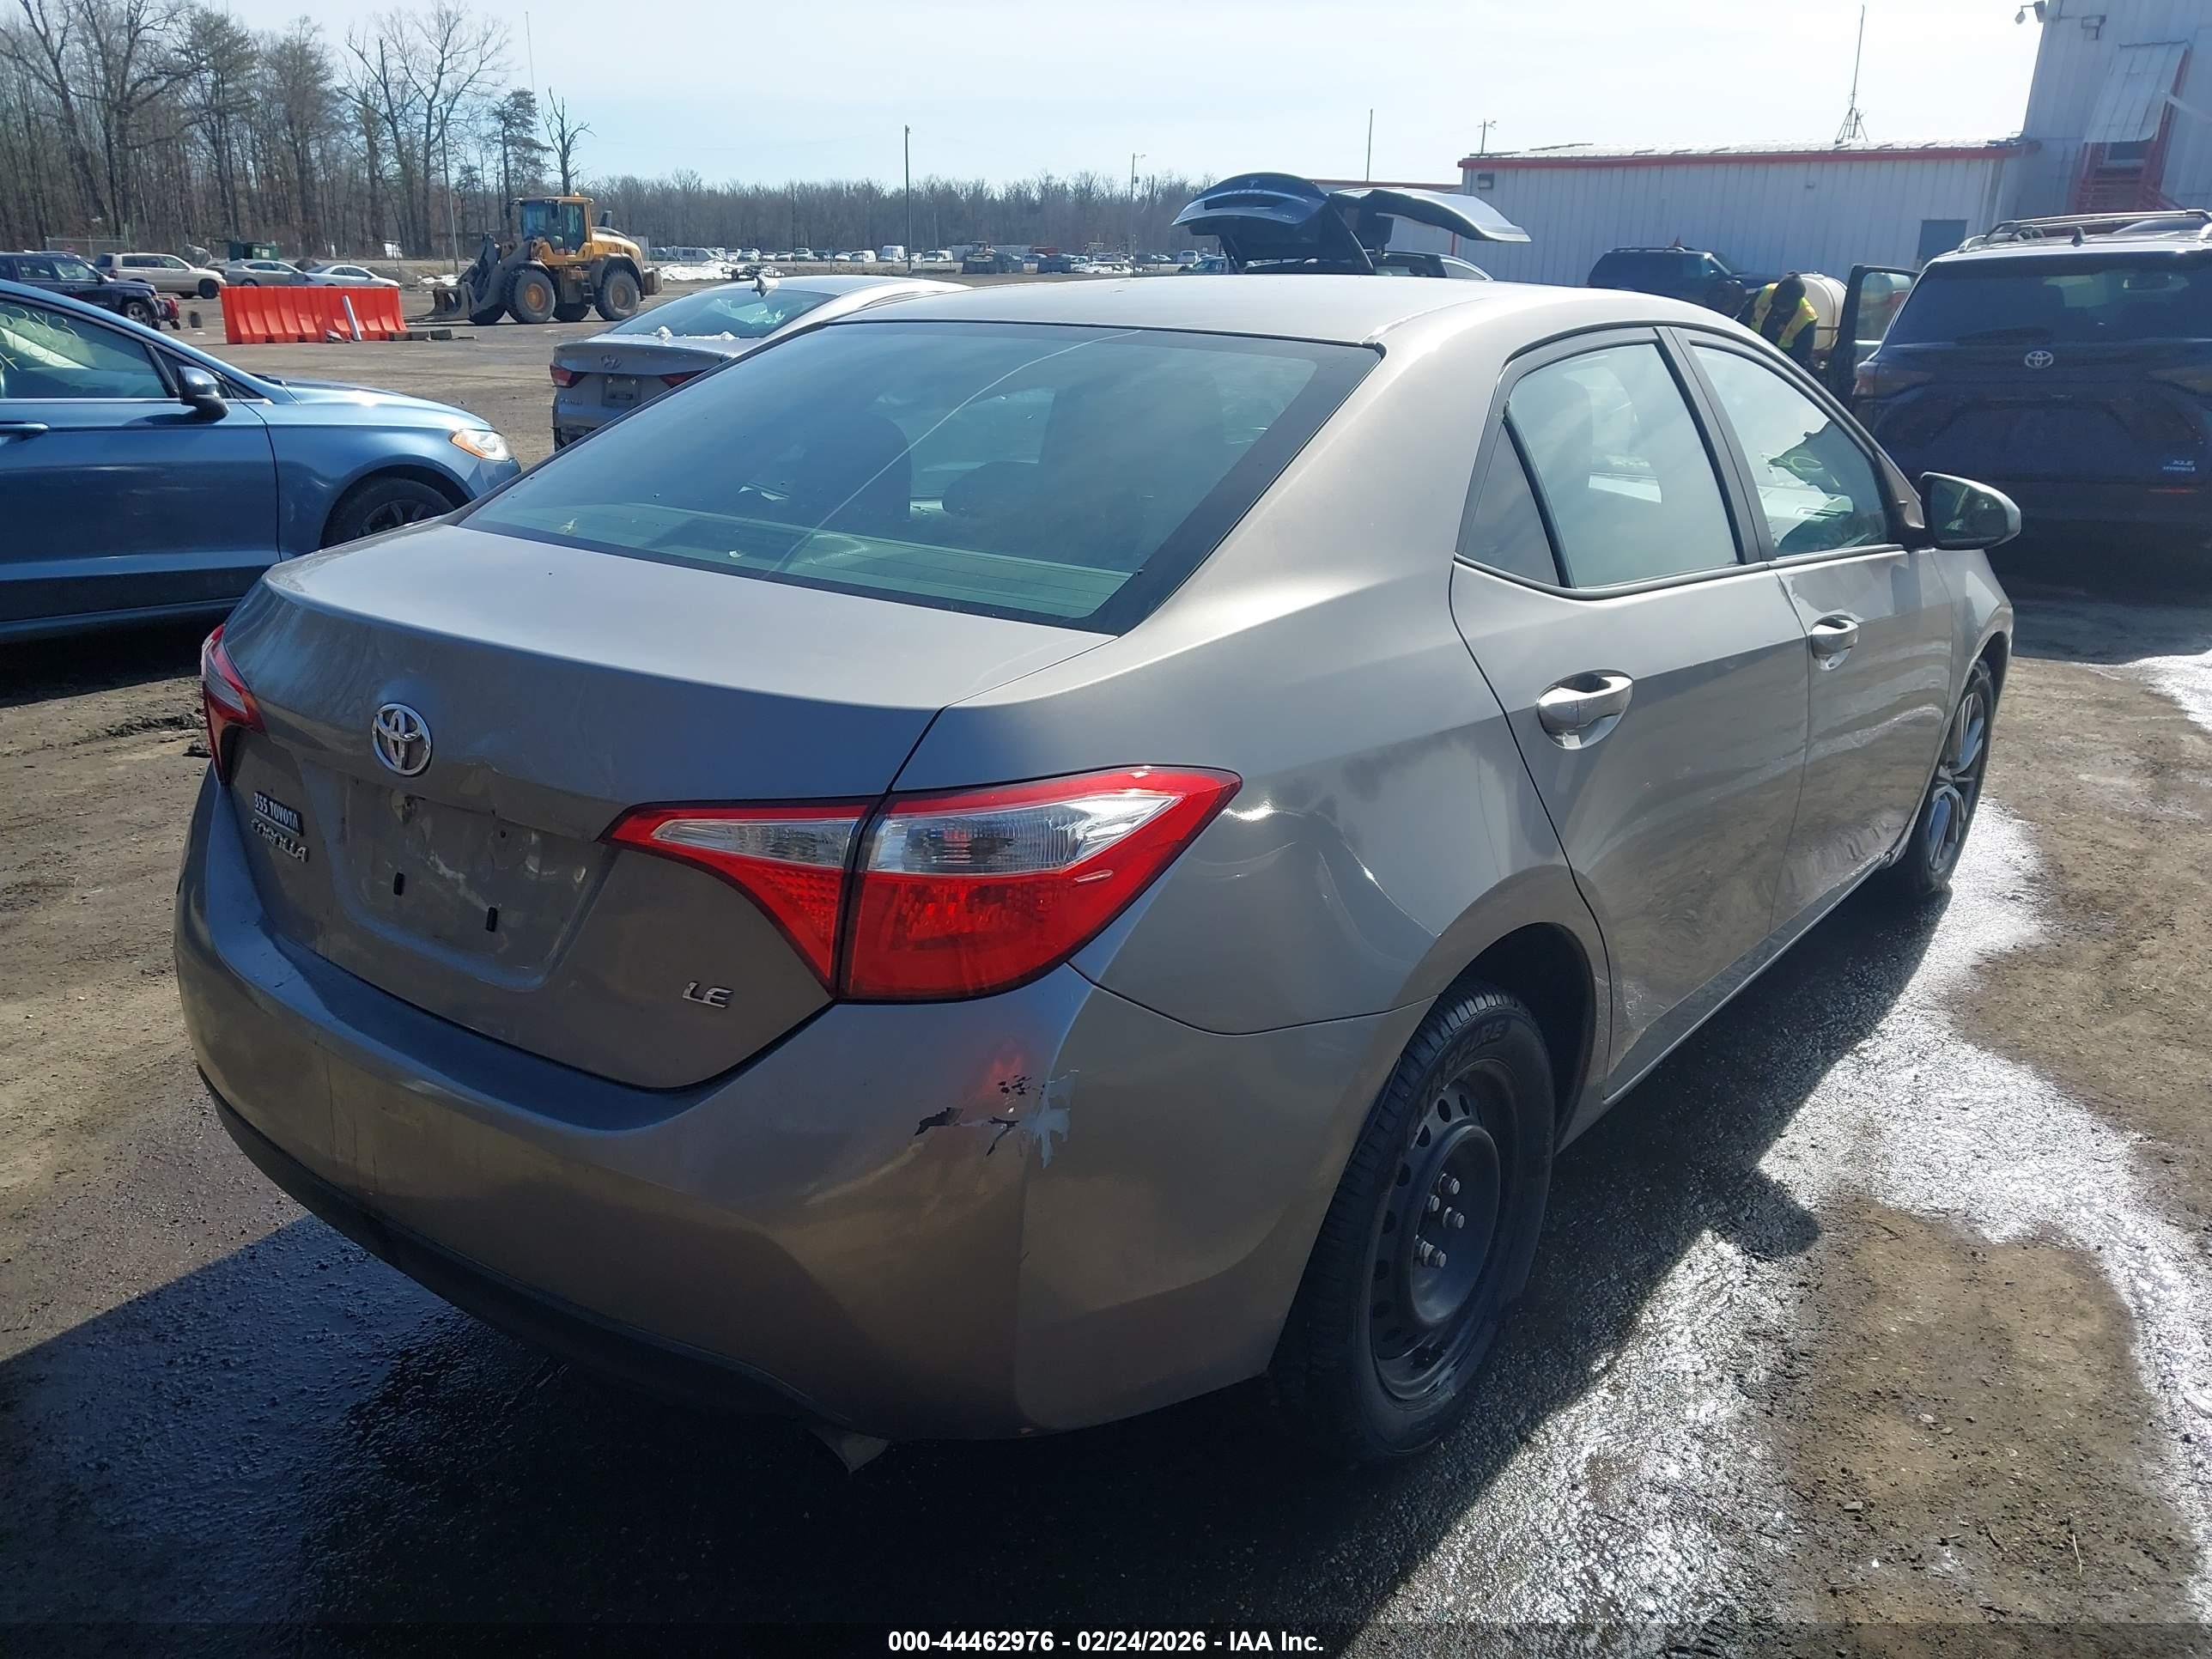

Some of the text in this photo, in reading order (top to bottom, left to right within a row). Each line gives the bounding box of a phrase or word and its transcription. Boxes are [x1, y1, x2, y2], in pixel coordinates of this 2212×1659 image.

[269, 801, 299, 830] TOYOTA
[250, 817, 307, 863] COROLLA
[683, 981, 734, 1008] LE
